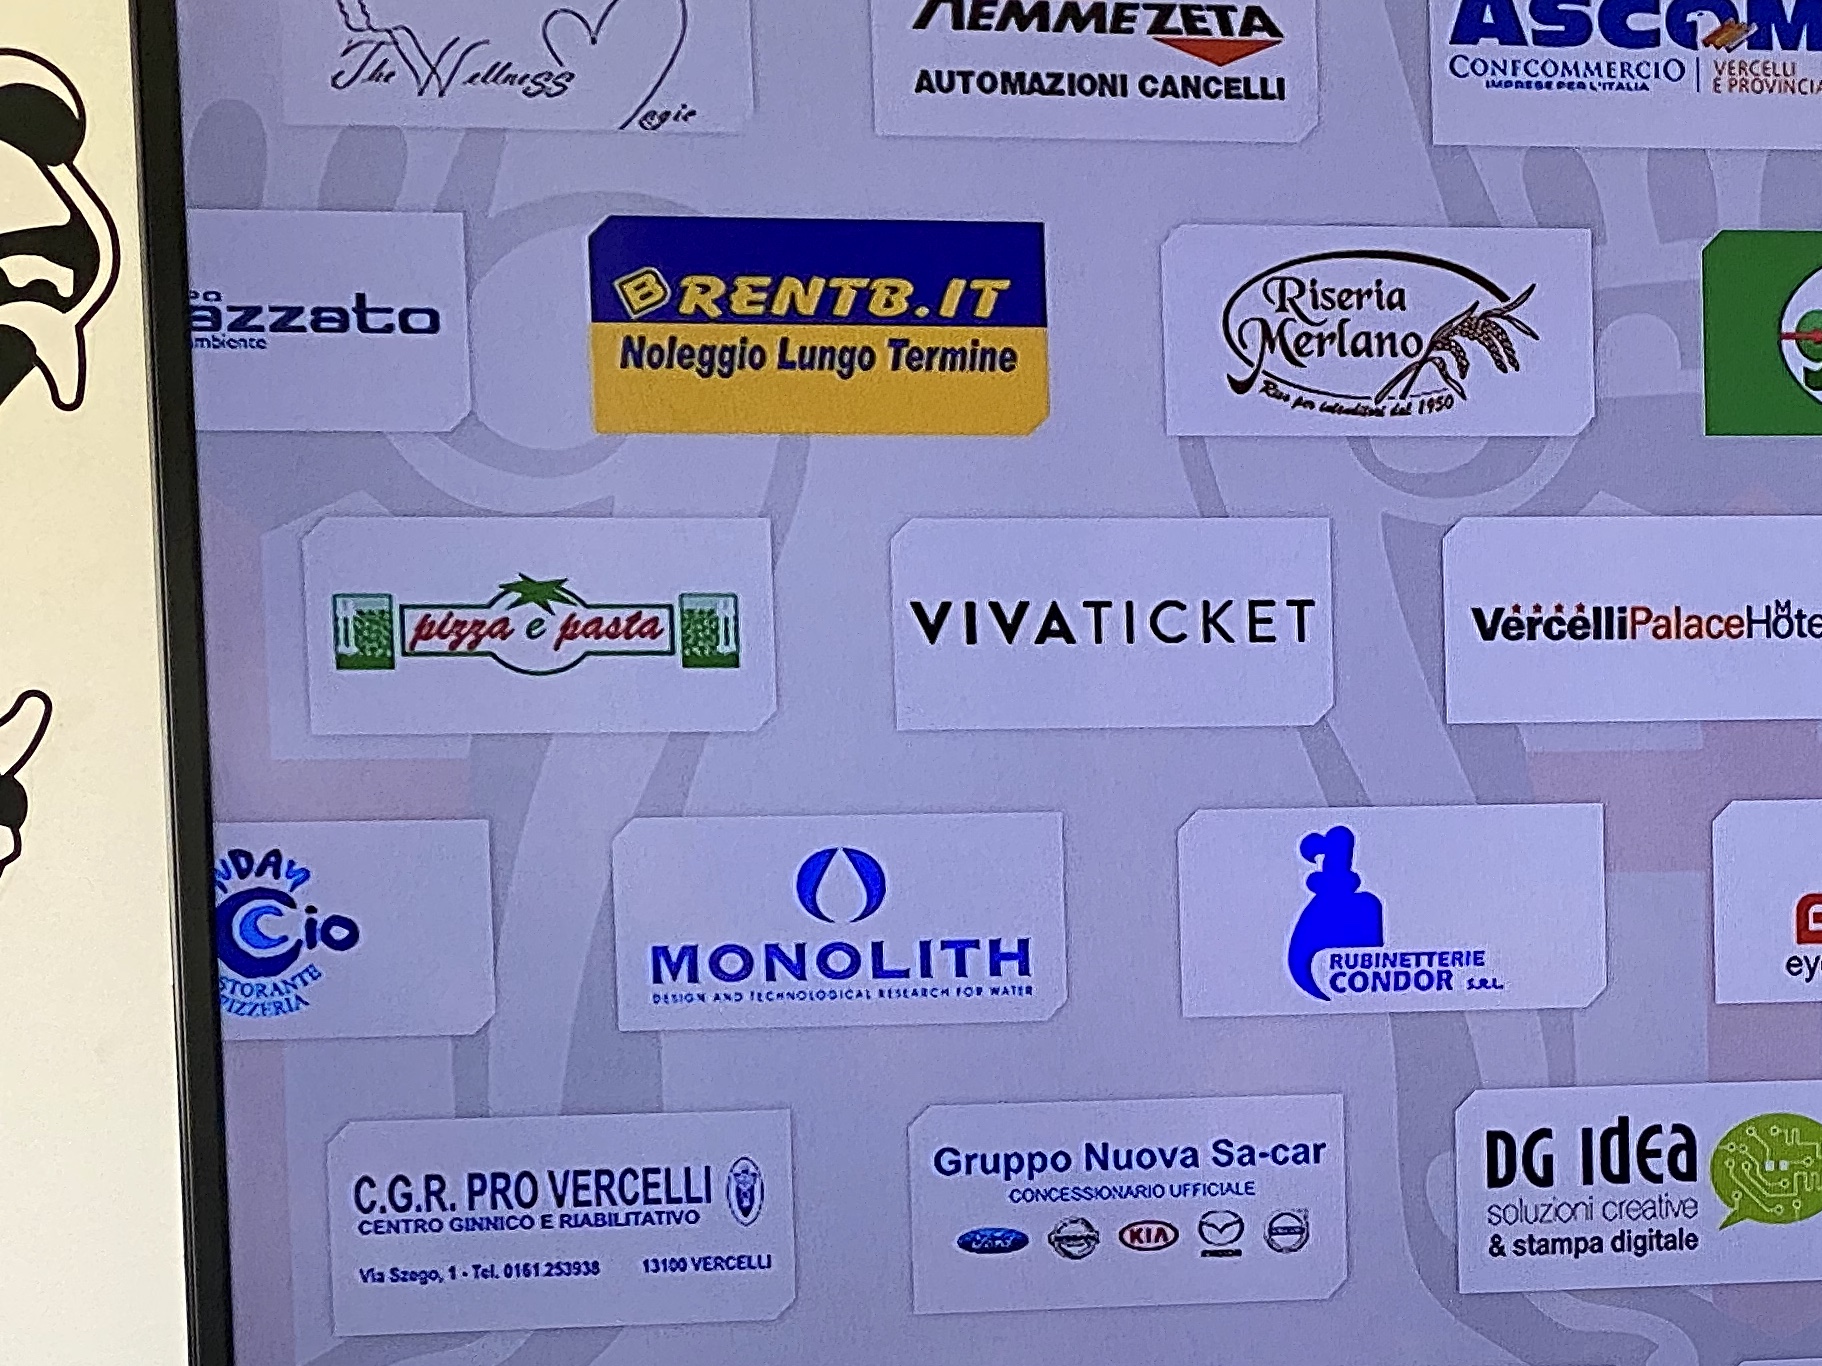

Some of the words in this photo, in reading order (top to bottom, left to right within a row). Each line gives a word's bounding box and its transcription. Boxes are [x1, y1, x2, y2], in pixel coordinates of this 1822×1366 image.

[331, 39, 396, 89] The
[392, 30, 575, 97] Wellness
[1714, 60, 1797, 77] VERCELLI
[915, 70, 1128, 97] AUTOMAZIONI
[1138, 74, 1286, 101] CANCELLI
[1714, 79, 1723, 93] E
[1263, 276, 1406, 327] Riseria
[619, 335, 767, 379] Noleggio
[777, 336, 877, 380] Lungo
[887, 338, 1019, 373] Termine
[1227, 316, 1424, 394] Merlano
[409, 611, 514, 651] pizza
[525, 615, 546, 640] e
[554, 610, 664, 651] pasta
[910, 599, 1316, 645] VIVATICKET
[651, 937, 1031, 985] MONOLITH
[1330, 950, 1486, 969] RUBINETTERIE
[1329, 969, 1454, 993] CONDOR
[933, 1146, 1072, 1181] Gruppo
[1084, 1141, 1200, 1172] Nuova
[1211, 1138, 1327, 1168] Sa-car
[1485, 1127, 1554, 1189] DG
[354, 1173, 456, 1215] C.G.R.
[467, 1170, 539, 1212] PRO
[547, 1165, 712, 1208] VERCELLI
[1008, 1184, 1165, 1204] CONCESSIONARIO
[1169, 1181, 1256, 1199] UFFICIALE
[358, 1217, 444, 1236] CENTRO
[450, 1214, 535, 1233] GINNICO
[540, 1213, 554, 1230] E
[559, 1209, 700, 1228] RIABILITATIVO
[1487, 1195, 1594, 1226] soluzioni
[1601, 1193, 1699, 1223] creative
[1129, 1226, 1169, 1245] KIA
[1488, 1234, 1506, 1258] &
[1512, 1231, 1604, 1260] stampa
[1610, 1227, 1699, 1258] digitale
[359, 1267, 386, 1285] Via
[643, 1257, 688, 1275] 13100
[691, 1254, 772, 1273] VERCELLI
